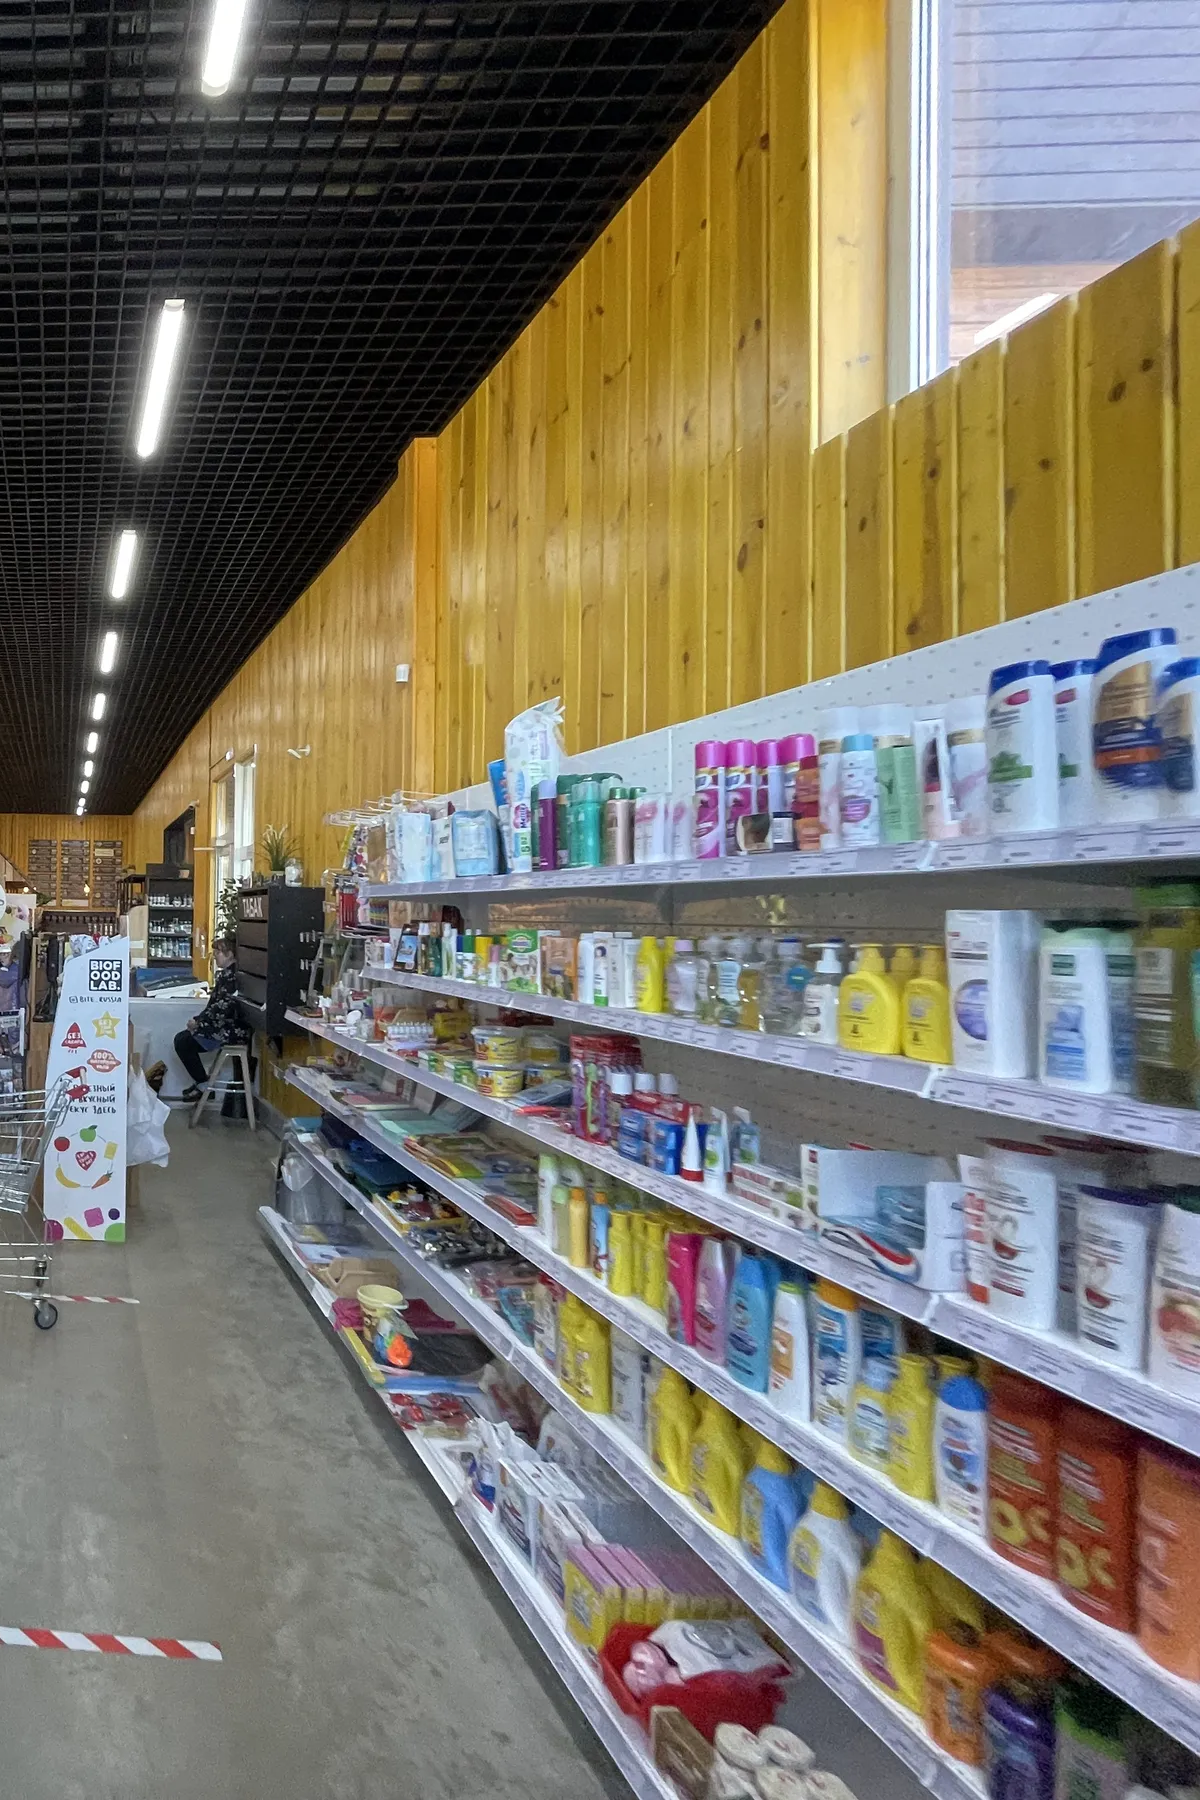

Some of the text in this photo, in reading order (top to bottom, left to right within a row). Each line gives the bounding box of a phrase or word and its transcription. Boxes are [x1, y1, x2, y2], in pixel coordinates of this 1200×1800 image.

[242, 897, 264, 918] ТАБАК
[90, 961, 121, 970] BIOF
[90, 971, 121, 980] OOD
[90, 981, 121, 990] LAB.
[92, 1105, 116, 1114] ЗДЕСЬ
